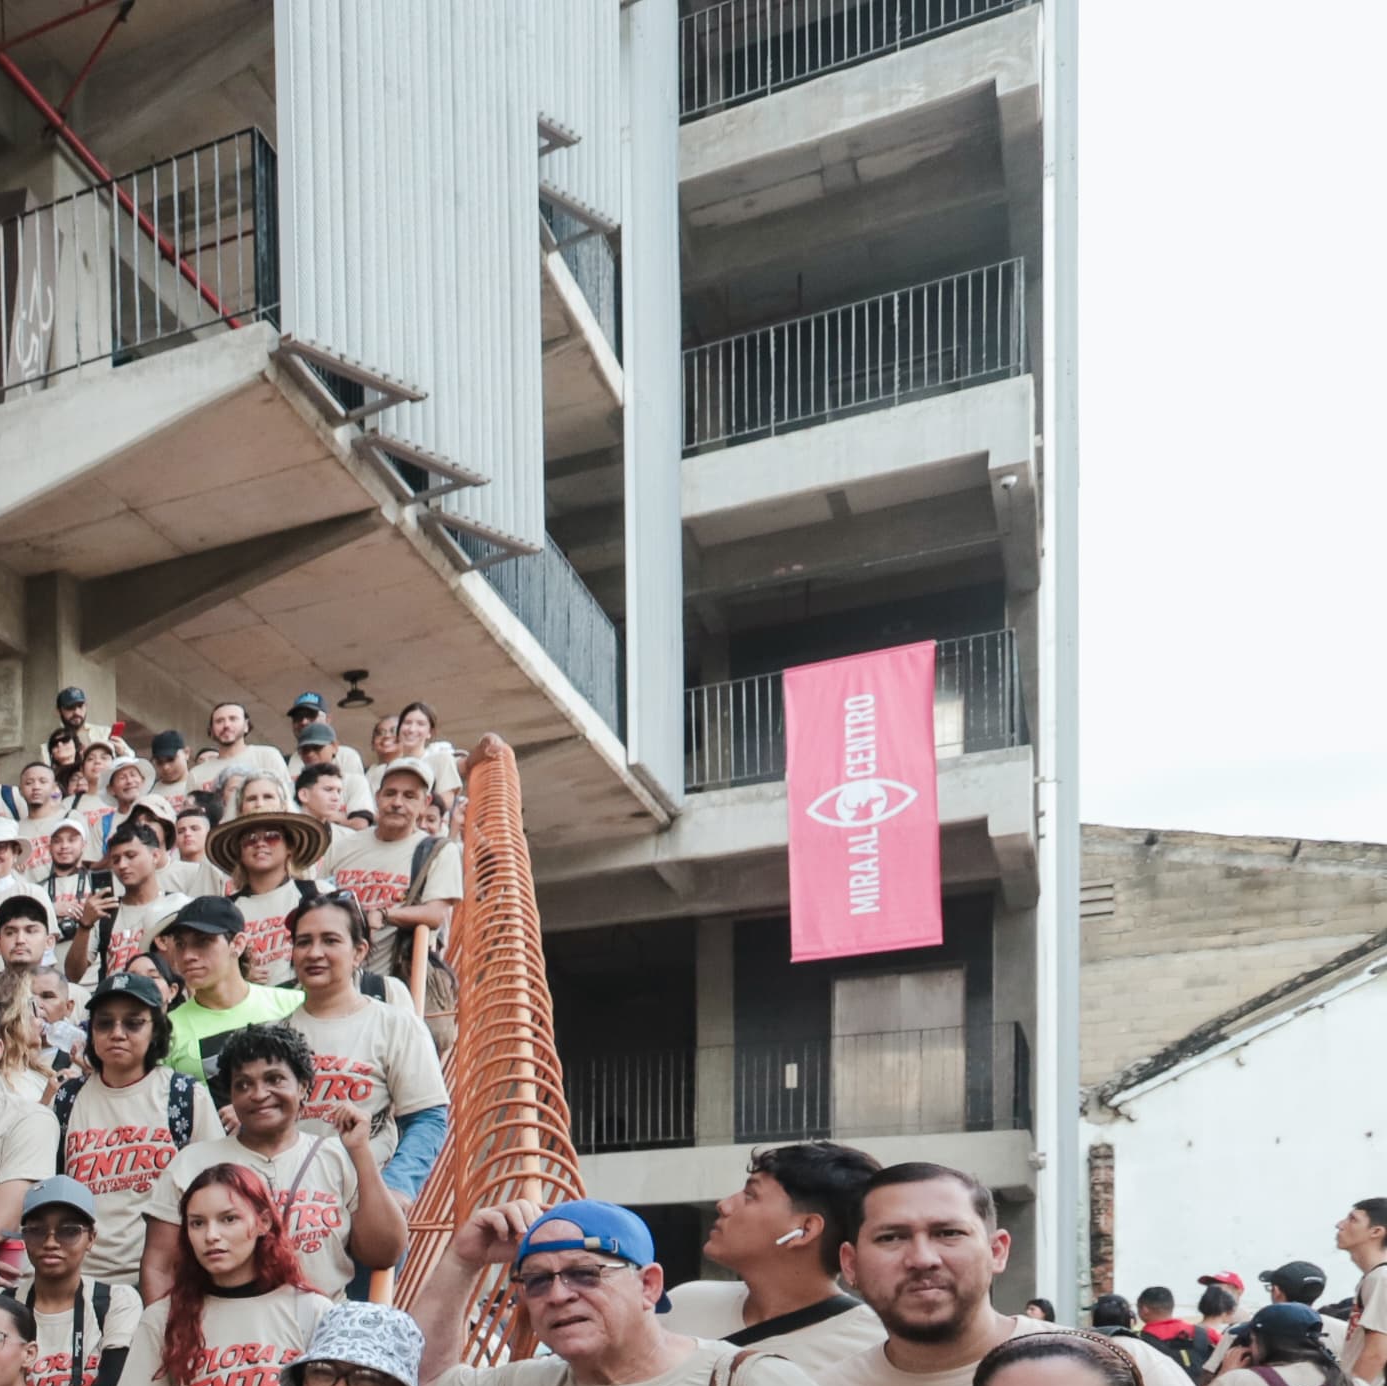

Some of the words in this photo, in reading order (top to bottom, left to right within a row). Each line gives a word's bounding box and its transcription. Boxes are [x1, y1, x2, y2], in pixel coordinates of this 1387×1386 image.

[844, 692, 876, 779] CENTRO
[847, 825, 879, 855] AL
[849, 856, 880, 915] MIRA
[308, 1073, 374, 1103] TRO
[67, 1126, 150, 1159] EXPLORA
[182, 1343, 276, 1385] PLORA
